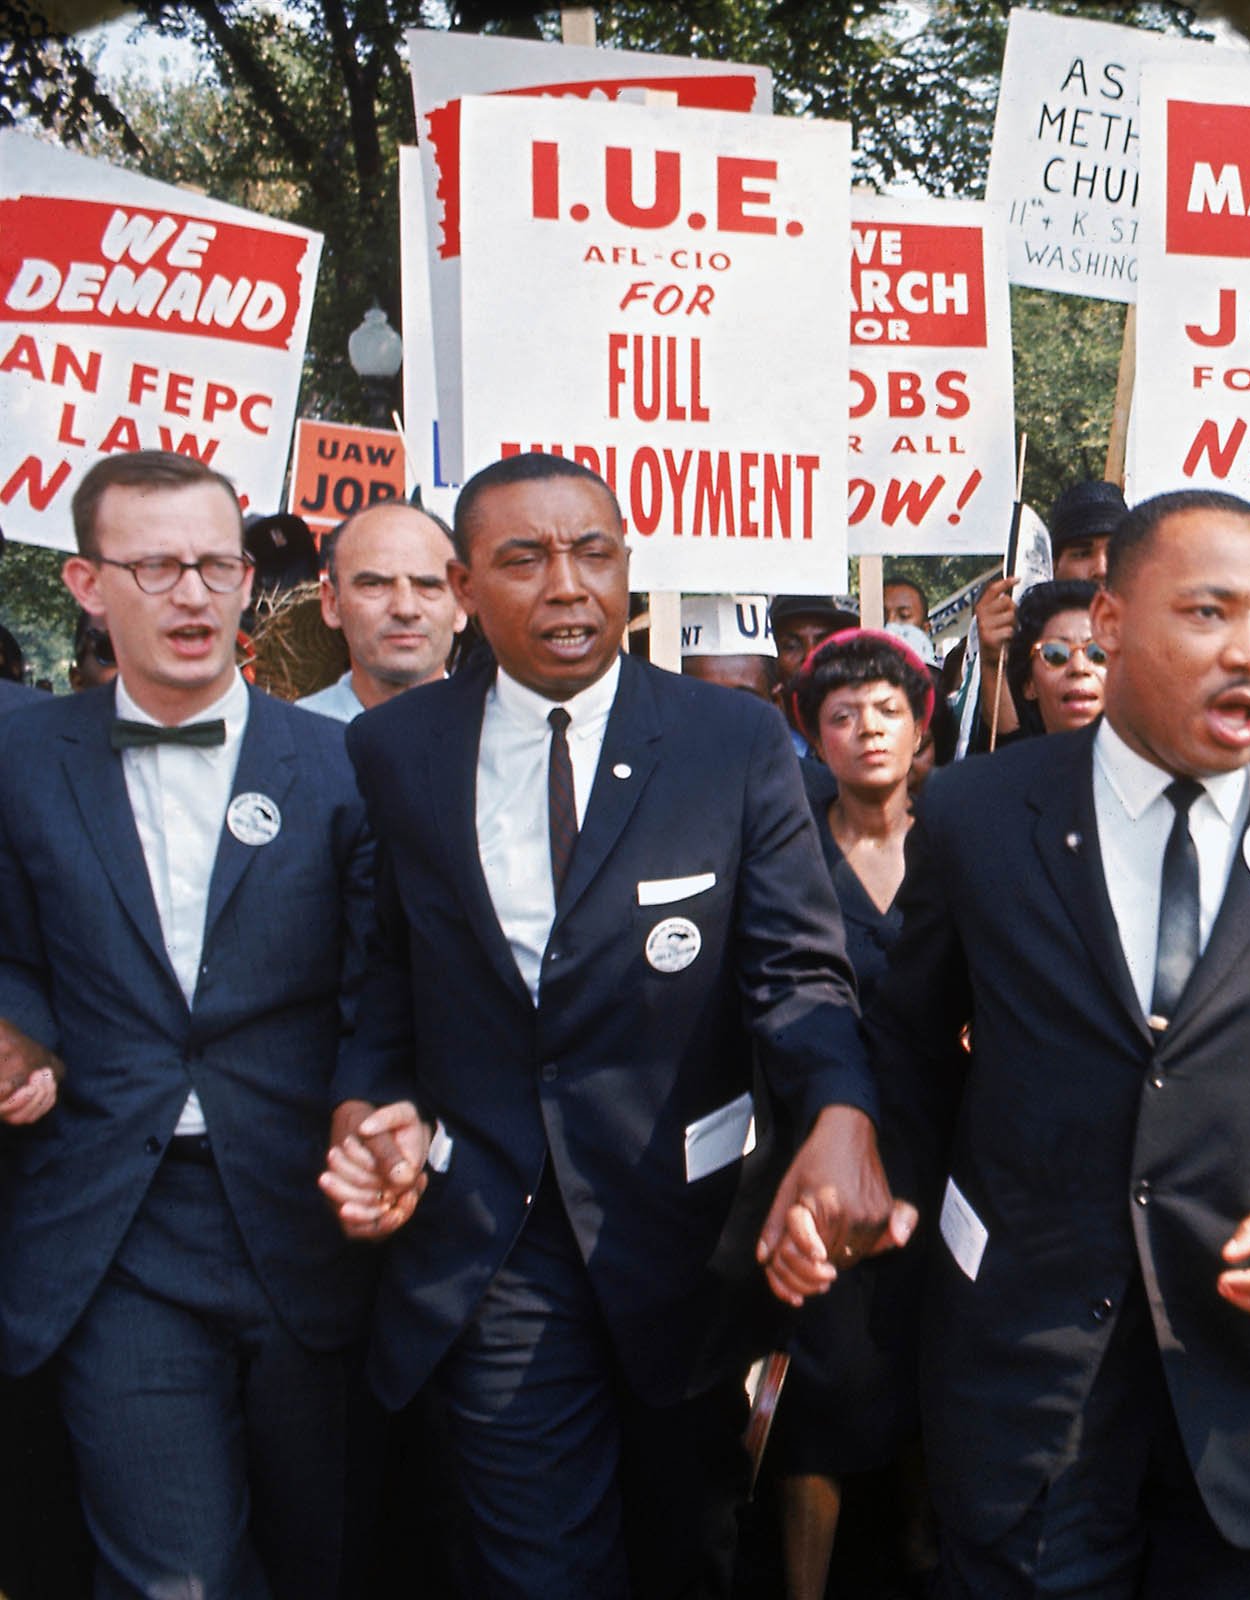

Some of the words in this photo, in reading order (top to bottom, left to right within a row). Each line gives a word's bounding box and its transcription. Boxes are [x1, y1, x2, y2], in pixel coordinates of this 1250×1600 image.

[1061, 57, 1126, 100] AS
[532, 140, 804, 237] I.U.E.
[1044, 157, 1139, 207] CHU
[102, 209, 217, 268] WE
[1072, 211, 1088, 236] K
[583, 245, 731, 271] AFL-CIO
[7, 258, 287, 331] DEMAND
[620, 281, 716, 316] FOR
[850, 269, 968, 315] RCH
[854, 318, 911, 341] OR
[0, 334, 102, 393] AN
[128, 363, 273, 436] FEPC
[608, 333, 710, 422] FULL
[848, 369, 971, 420] OBS
[58, 403, 220, 467] LAW
[318, 438, 395, 467] UAW
[891, 435, 966, 454] ALL
[500, 443, 819, 539] LOYMENT
[848, 469, 982, 527] OW!
